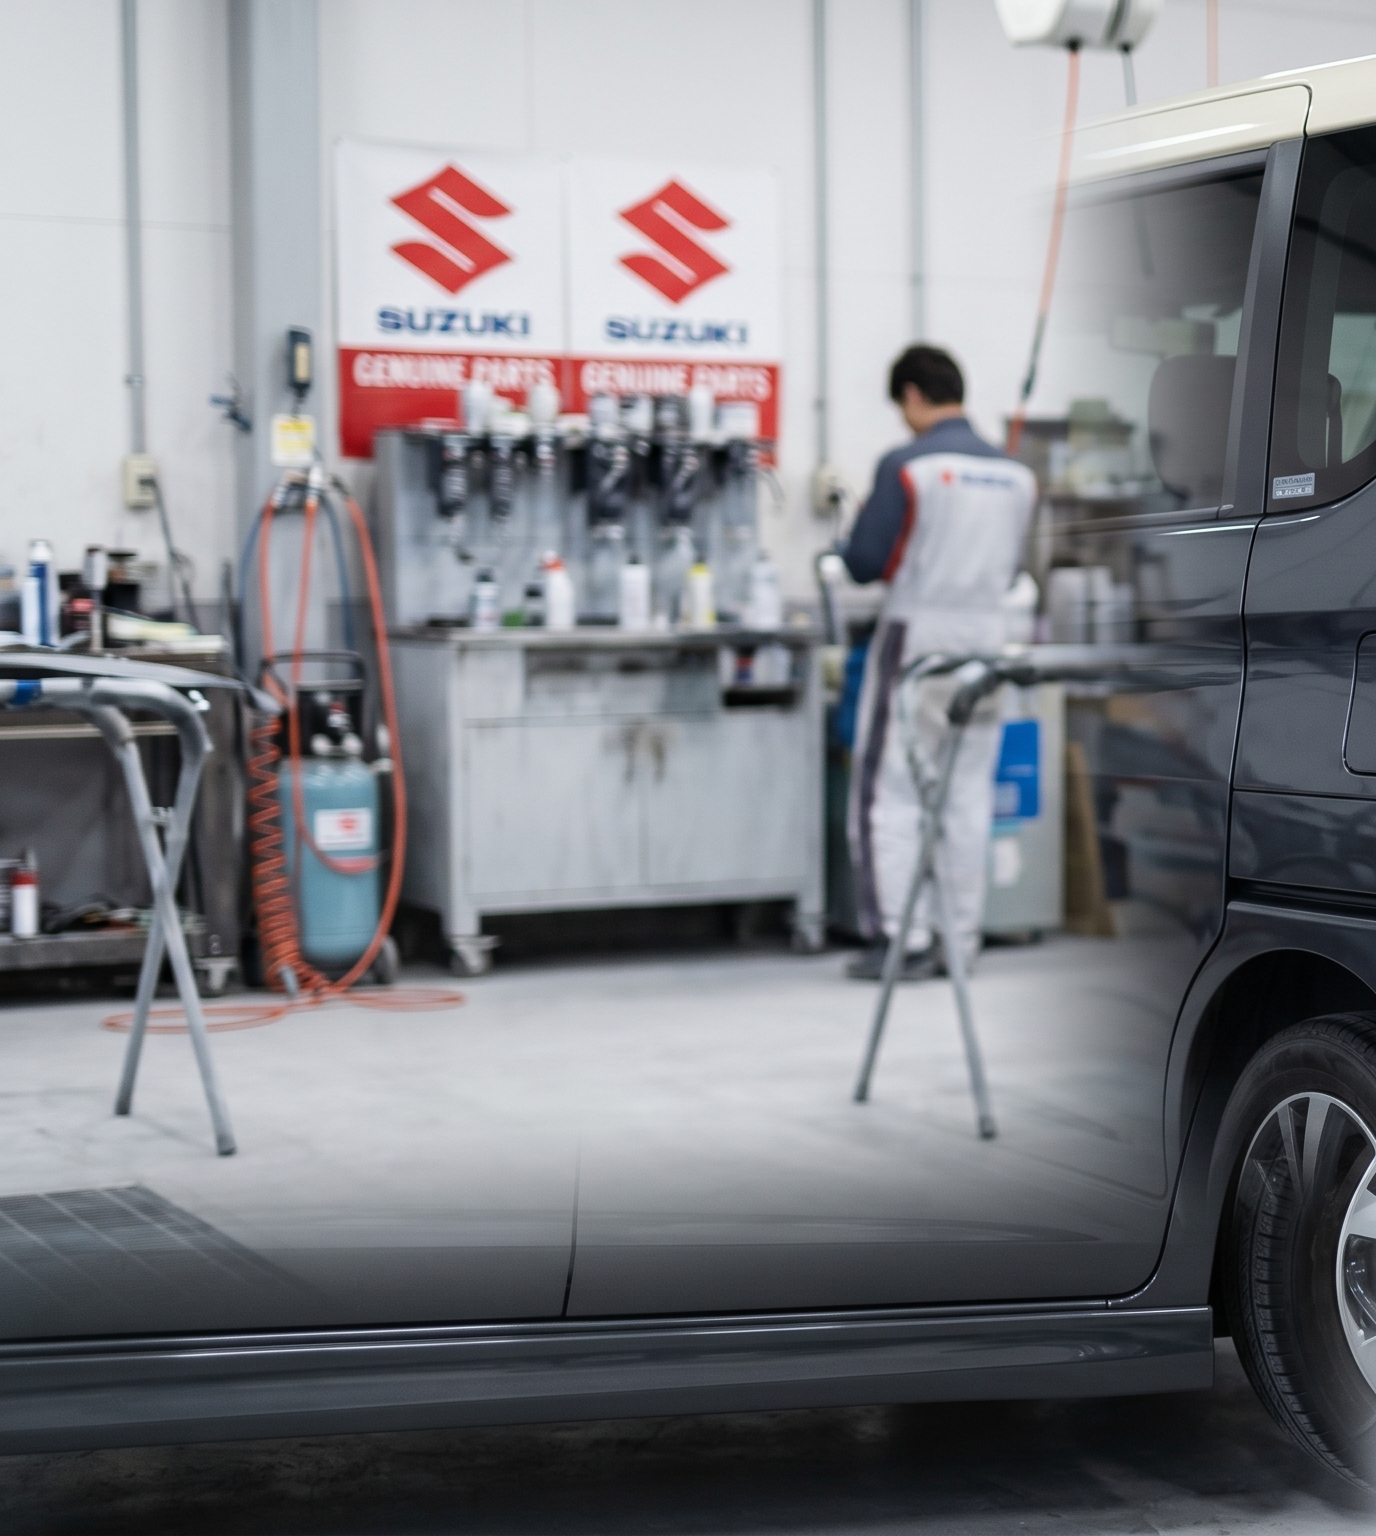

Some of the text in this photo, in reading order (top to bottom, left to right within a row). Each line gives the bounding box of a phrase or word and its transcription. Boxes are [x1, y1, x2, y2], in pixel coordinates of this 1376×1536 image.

[377, 306, 531, 337] SUZUKI
[605, 315, 748, 345] SUZUKI
[353, 353, 468, 389] GENUINE
[581, 361, 688, 396] GENUINE
